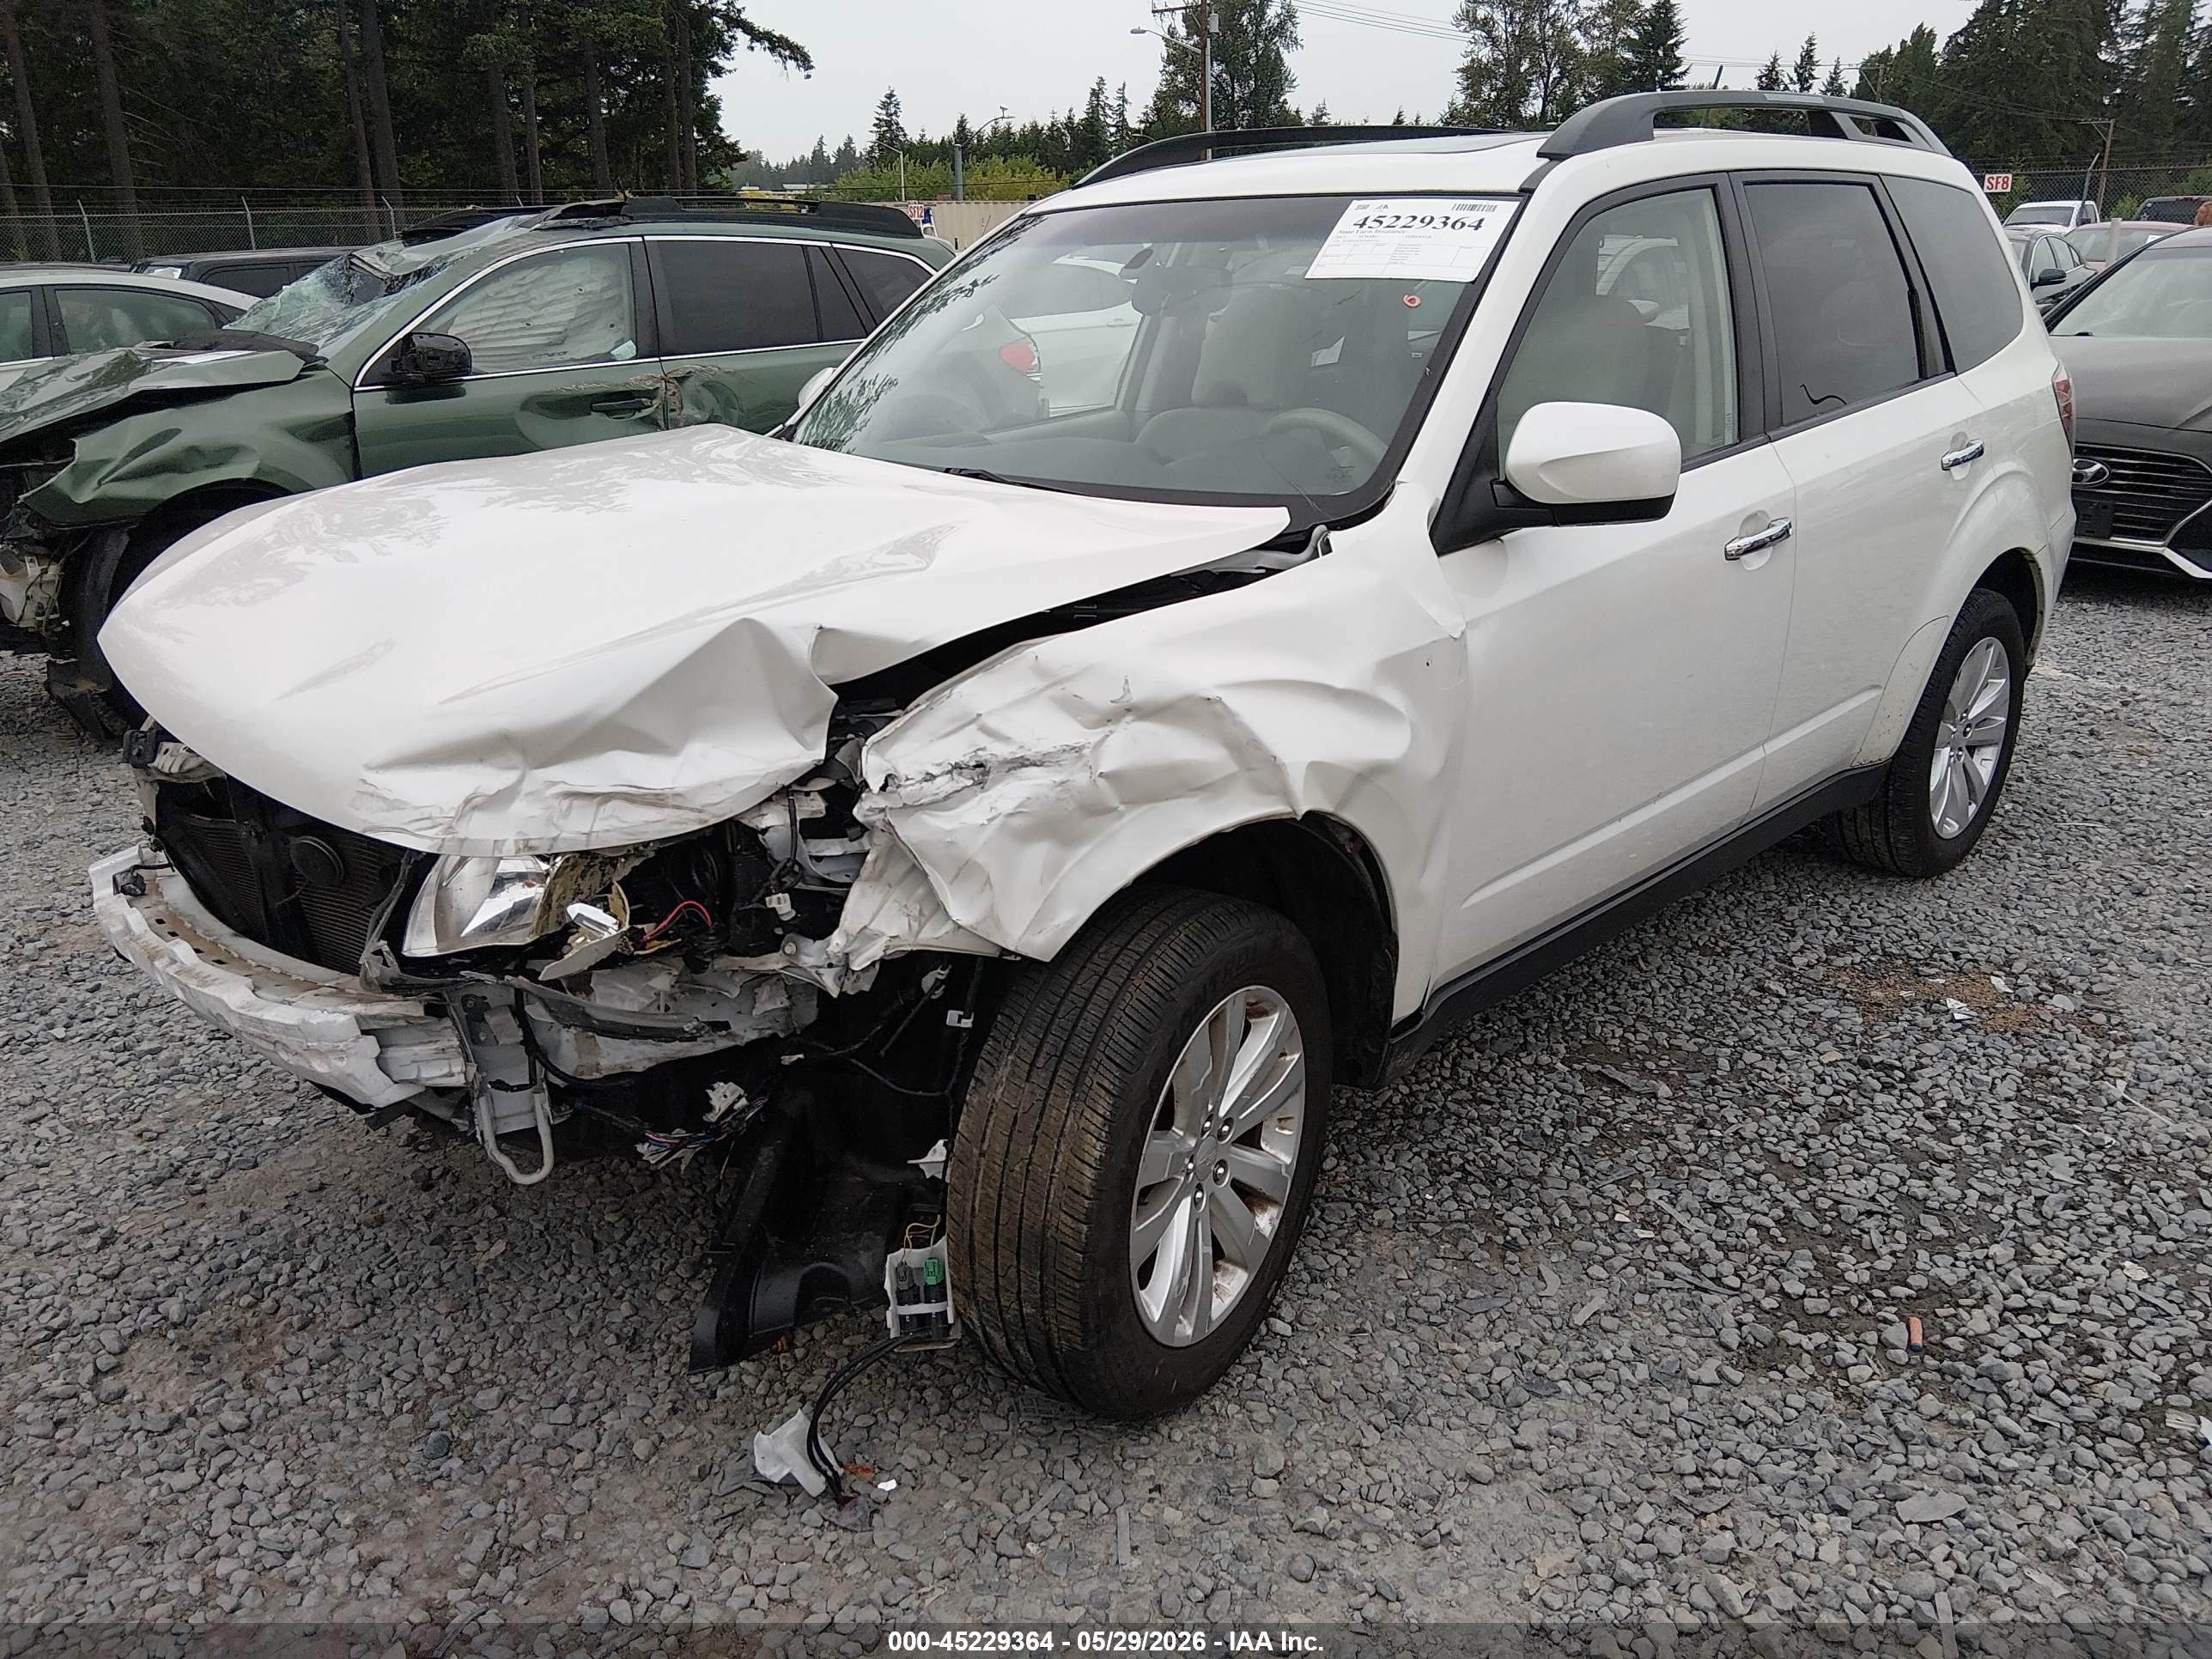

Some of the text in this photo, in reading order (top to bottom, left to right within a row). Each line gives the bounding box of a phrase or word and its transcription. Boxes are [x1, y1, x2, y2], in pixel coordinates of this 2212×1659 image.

[1987, 176, 2009, 190] SF8
[909, 206, 923, 218] SF12
[1353, 215, 1485, 231] 45229364
